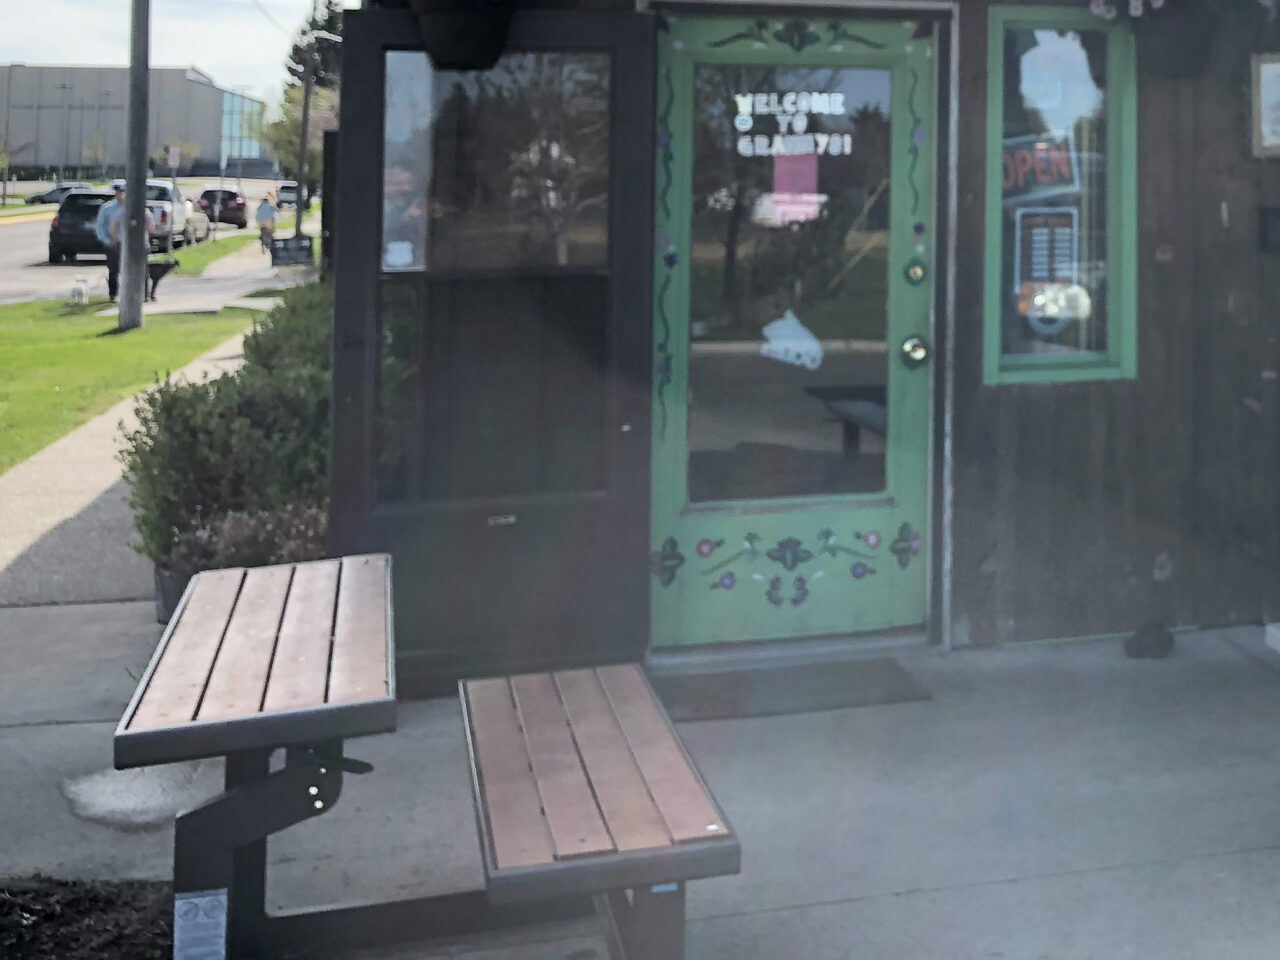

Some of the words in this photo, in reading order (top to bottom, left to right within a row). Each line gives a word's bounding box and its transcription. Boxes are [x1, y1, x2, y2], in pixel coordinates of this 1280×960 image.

[734, 92, 845, 115] WELCOME
[775, 112, 808, 133] TO
[1002, 144, 1071, 190] OPEN
